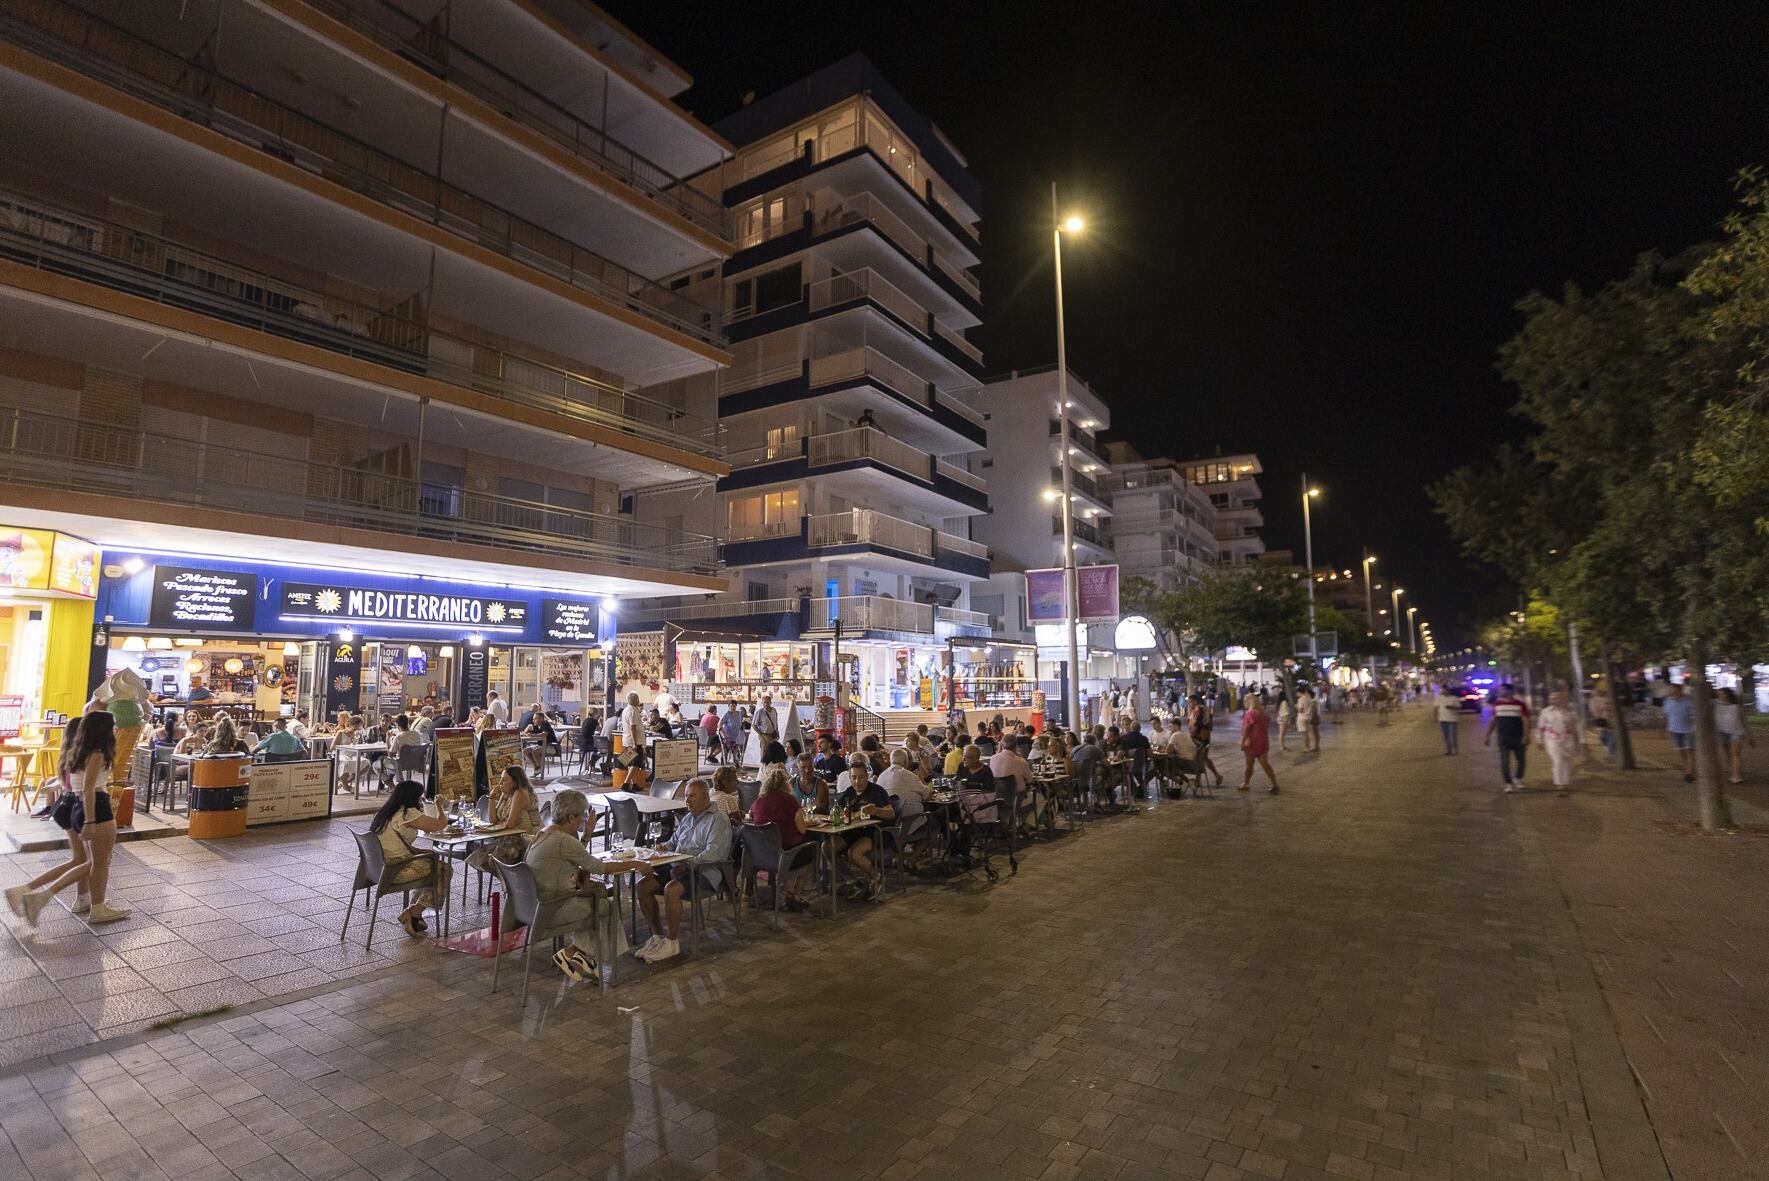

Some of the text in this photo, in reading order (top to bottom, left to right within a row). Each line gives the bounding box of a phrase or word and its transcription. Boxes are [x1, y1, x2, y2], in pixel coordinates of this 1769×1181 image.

[176, 572, 238, 586] Mariscos
[162, 581, 248, 596] Pescado fresco
[180, 593, 231, 603] Arroces
[347, 590, 482, 623] MEDITERRANEO
[172, 610, 235, 622] Bocadillos
[304, 773, 320, 781] 29€
